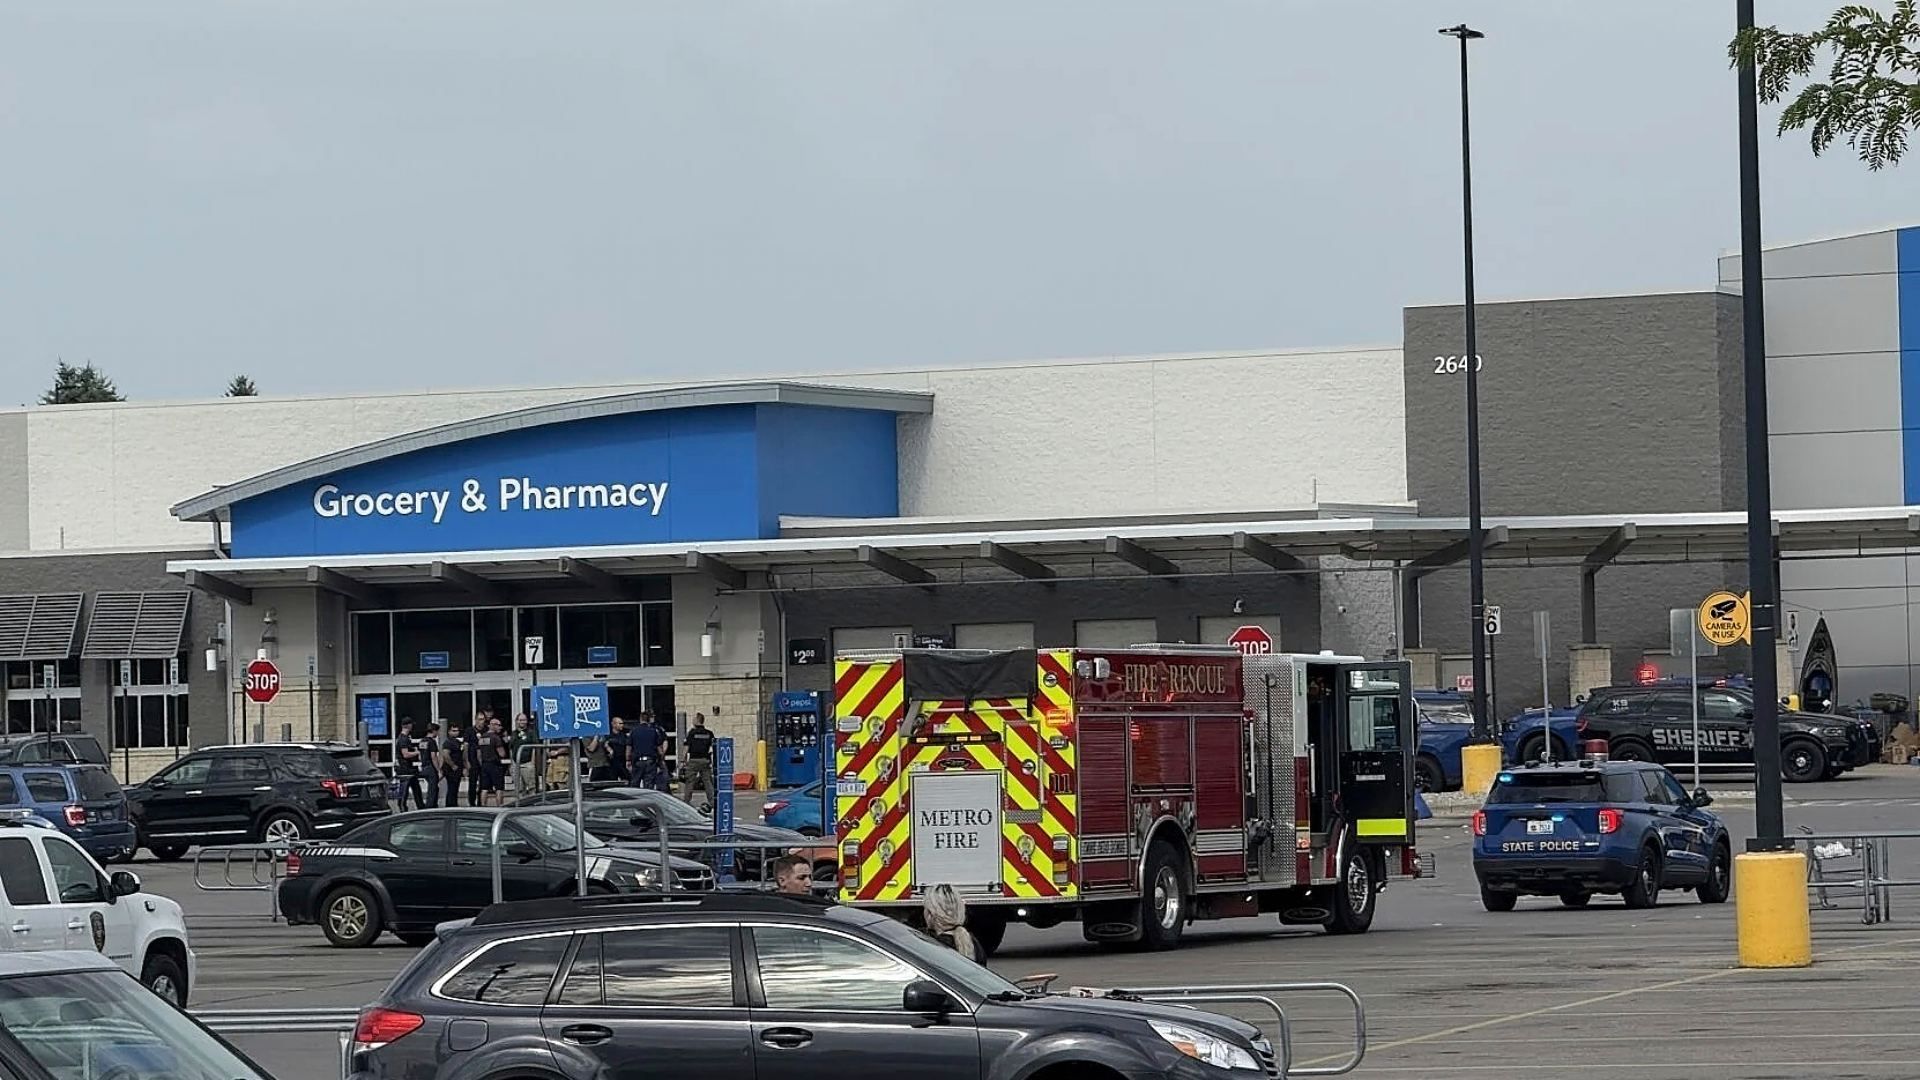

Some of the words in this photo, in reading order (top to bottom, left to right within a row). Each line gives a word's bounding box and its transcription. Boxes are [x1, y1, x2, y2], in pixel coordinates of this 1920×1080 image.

[313, 484, 450, 523] Grocery
[461, 478, 487, 512] &
[499, 477, 669, 516] Pharmacy
[1486, 616, 1497, 633] 6
[1705, 622, 1741, 630] CAMERAS
[1711, 630, 1720, 638] IN
[1722, 630, 1735, 638] USE
[529, 645, 539, 663] 7
[246, 674, 278, 690] STOP
[1124, 664, 1158, 693] FIRE
[1169, 664, 1226, 694] RESCUE
[790, 699, 812, 707] pepsi
[1652, 729, 1740, 746] SHERIFF
[720, 746, 731, 763] 20
[1052, 773, 1073, 794] 11
[921, 809, 993, 827] METRO
[934, 832, 979, 849] FIRE
[1502, 841, 1535, 852] STATE
[1540, 841, 1580, 851] POLICE
